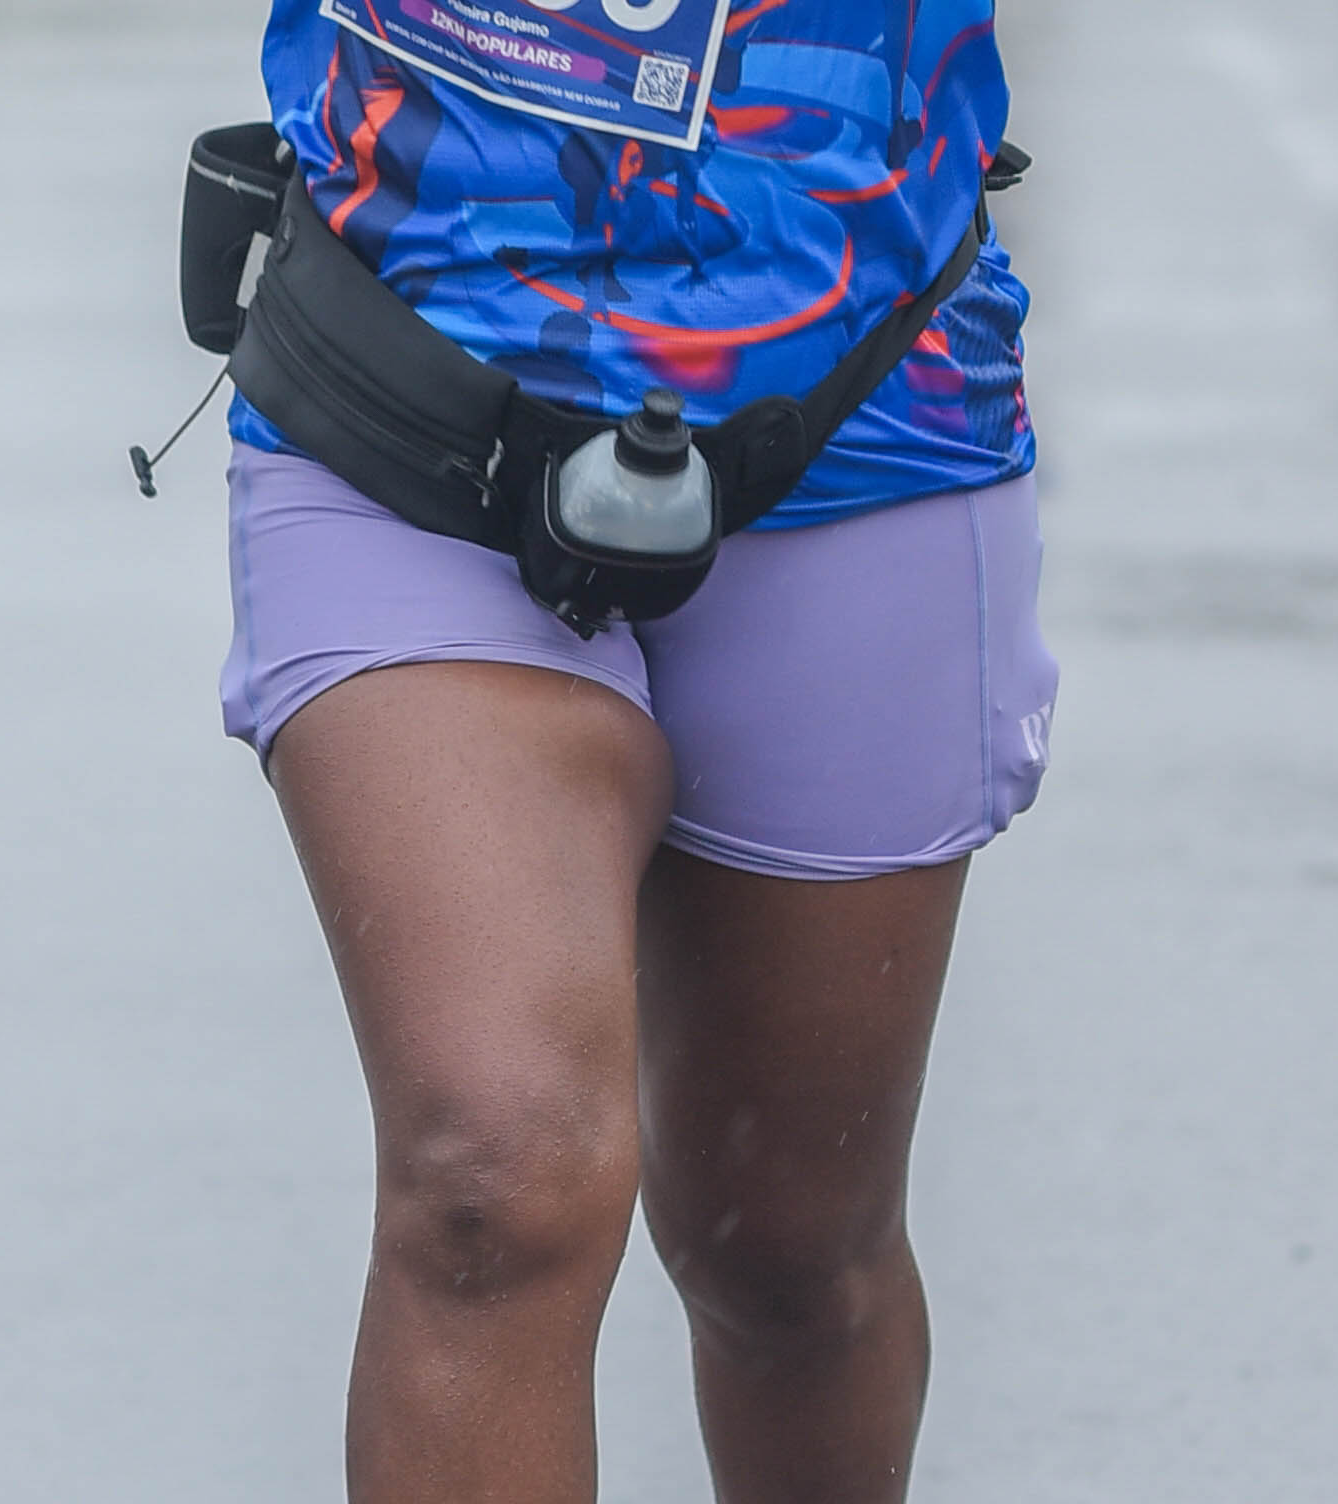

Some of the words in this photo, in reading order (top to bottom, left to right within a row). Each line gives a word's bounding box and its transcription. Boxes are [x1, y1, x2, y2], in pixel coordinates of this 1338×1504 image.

[430, 8, 465, 40] 12KM
[466, 30, 573, 72] POPULARES
[493, 10, 550, 38] Gujamo
